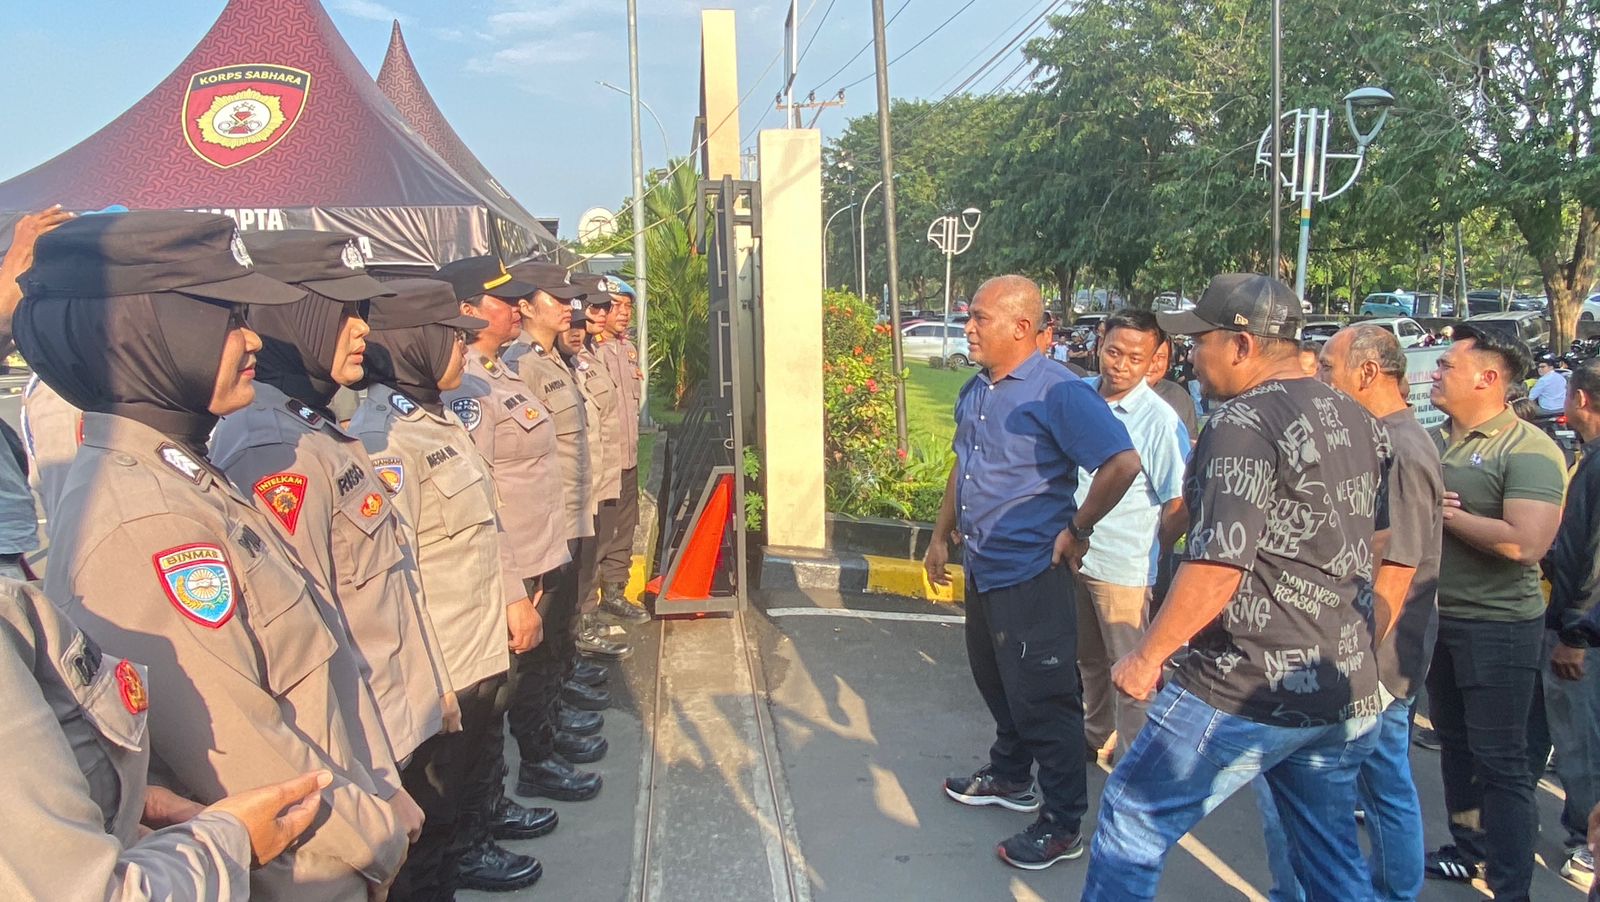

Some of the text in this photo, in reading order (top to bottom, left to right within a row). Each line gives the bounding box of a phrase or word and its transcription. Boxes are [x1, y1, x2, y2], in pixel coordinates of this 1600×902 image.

[200, 70, 302, 86] KORPS SABHARA
[257, 476, 303, 492] INTELKAM
[167, 550, 219, 566] BINMAS
[1273, 583, 1322, 621] REASON
[1312, 585, 1342, 609] NEED
[1264, 644, 1321, 672] NEW
[1338, 690, 1381, 722] WEEKEN
